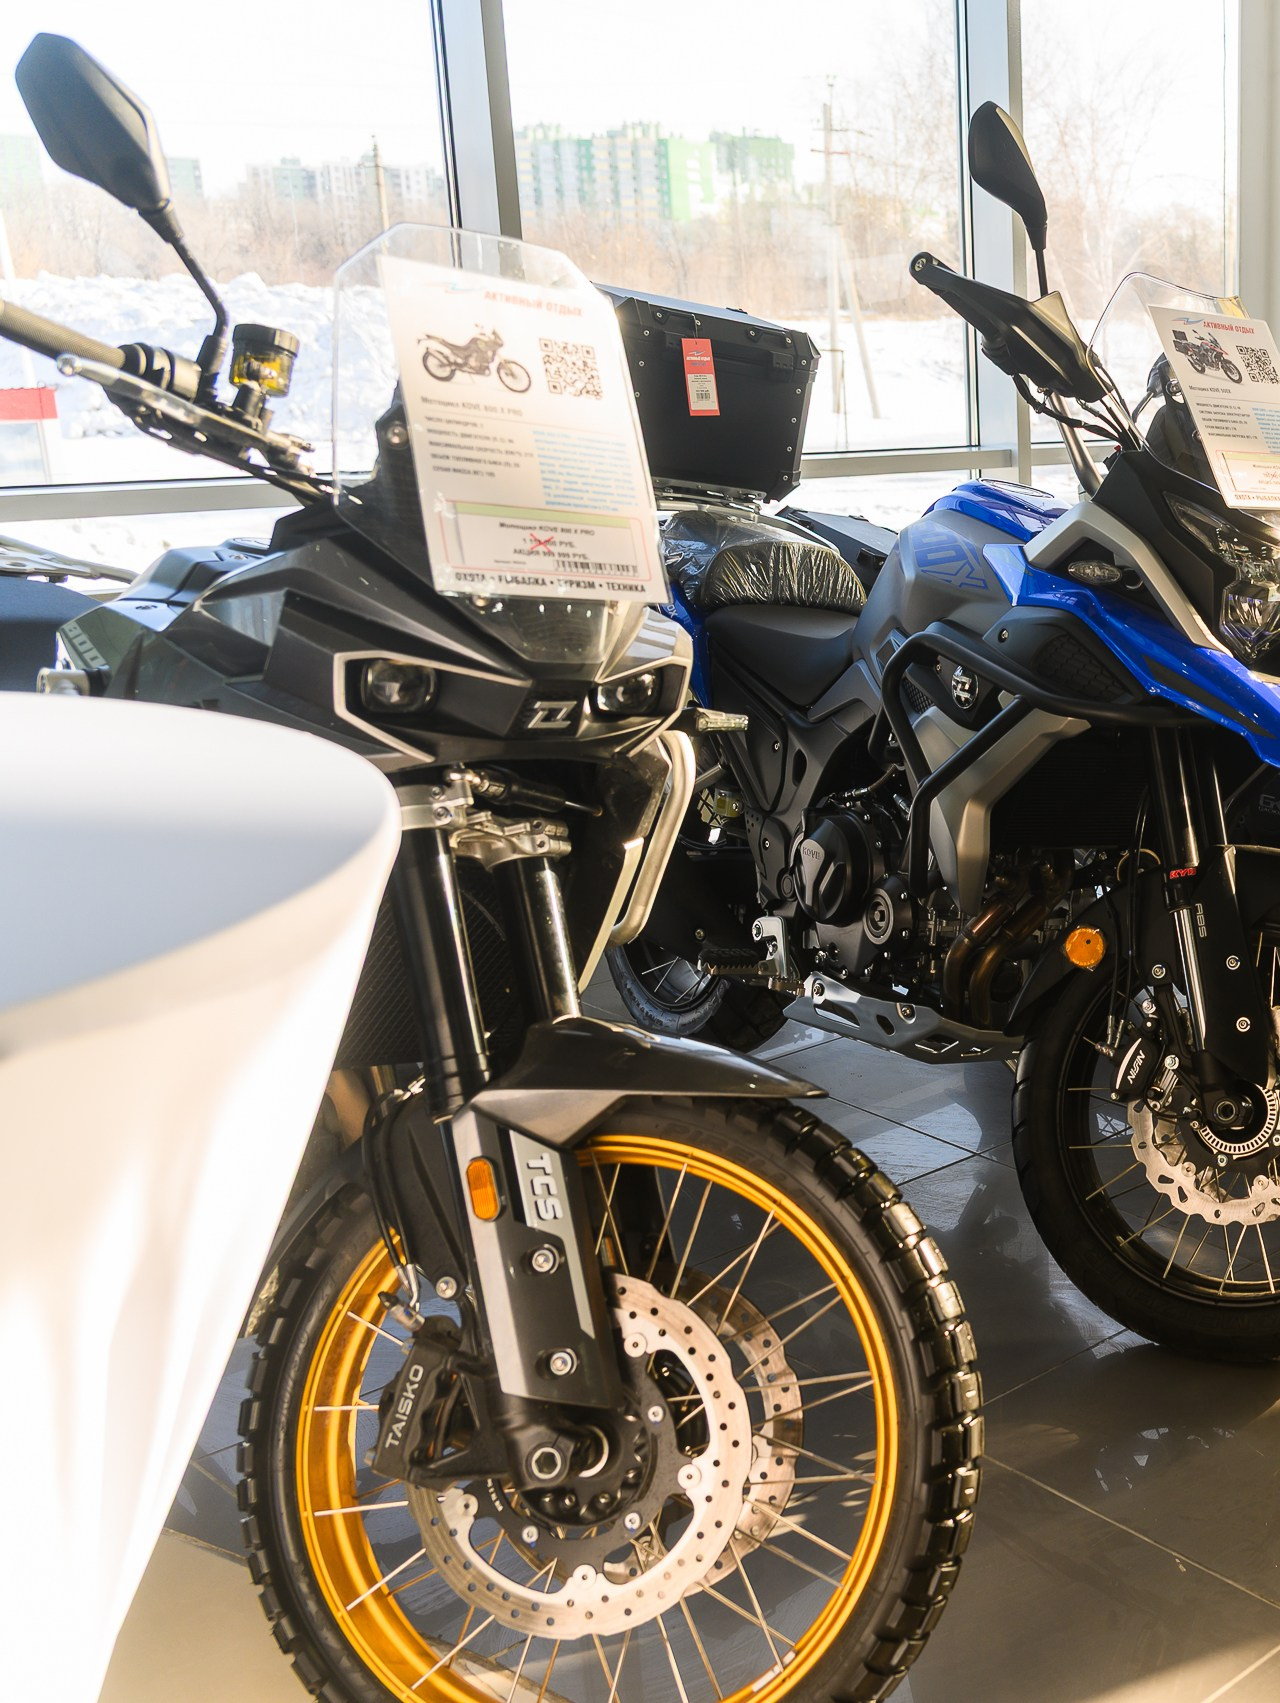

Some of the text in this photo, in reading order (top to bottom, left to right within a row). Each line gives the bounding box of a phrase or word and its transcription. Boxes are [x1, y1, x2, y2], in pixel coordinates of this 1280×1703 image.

[484, 290, 583, 318] АКТИВНЫЙ ОТДЫХ
[1203, 321, 1255, 334] АКТИВНЫЙ ОТДЫХ
[606, 581, 647, 593] ТЕХНИКА
[802, 846, 821, 860] KOVE
[1169, 867, 1197, 880] KYB
[1195, 903, 1208, 938] ABS
[1127, 1049, 1146, 1085] NISSIN
[527, 1152, 564, 1221] TCS
[385, 1364, 424, 1449] TAISKO
